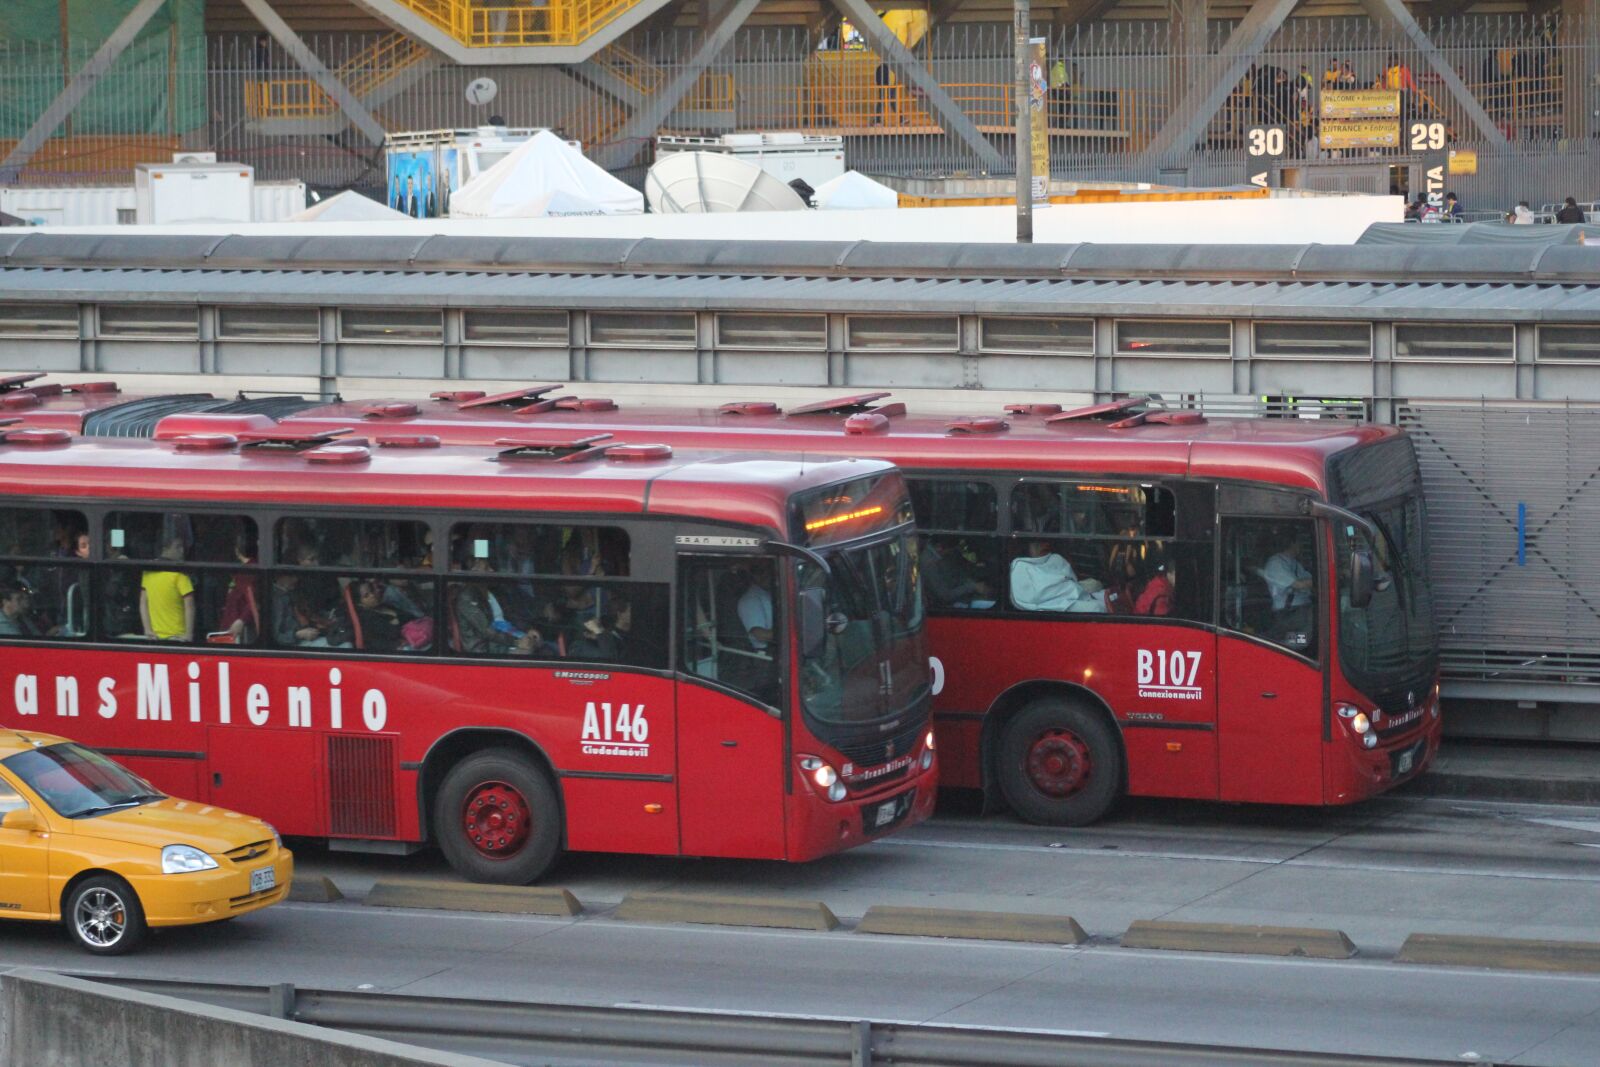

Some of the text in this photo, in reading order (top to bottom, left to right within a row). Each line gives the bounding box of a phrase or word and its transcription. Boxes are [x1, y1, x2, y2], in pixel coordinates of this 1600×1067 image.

[1249, 128, 1284, 156] 30
[1411, 123, 1444, 150] 29
[1427, 165, 1443, 212] RTA
[721, 537, 760, 546] VIALE
[560, 671, 609, 680] Marcopolo
[1137, 649, 1202, 686] B107
[581, 701, 649, 743] A146
[1126, 712, 1164, 720] VOLVO
